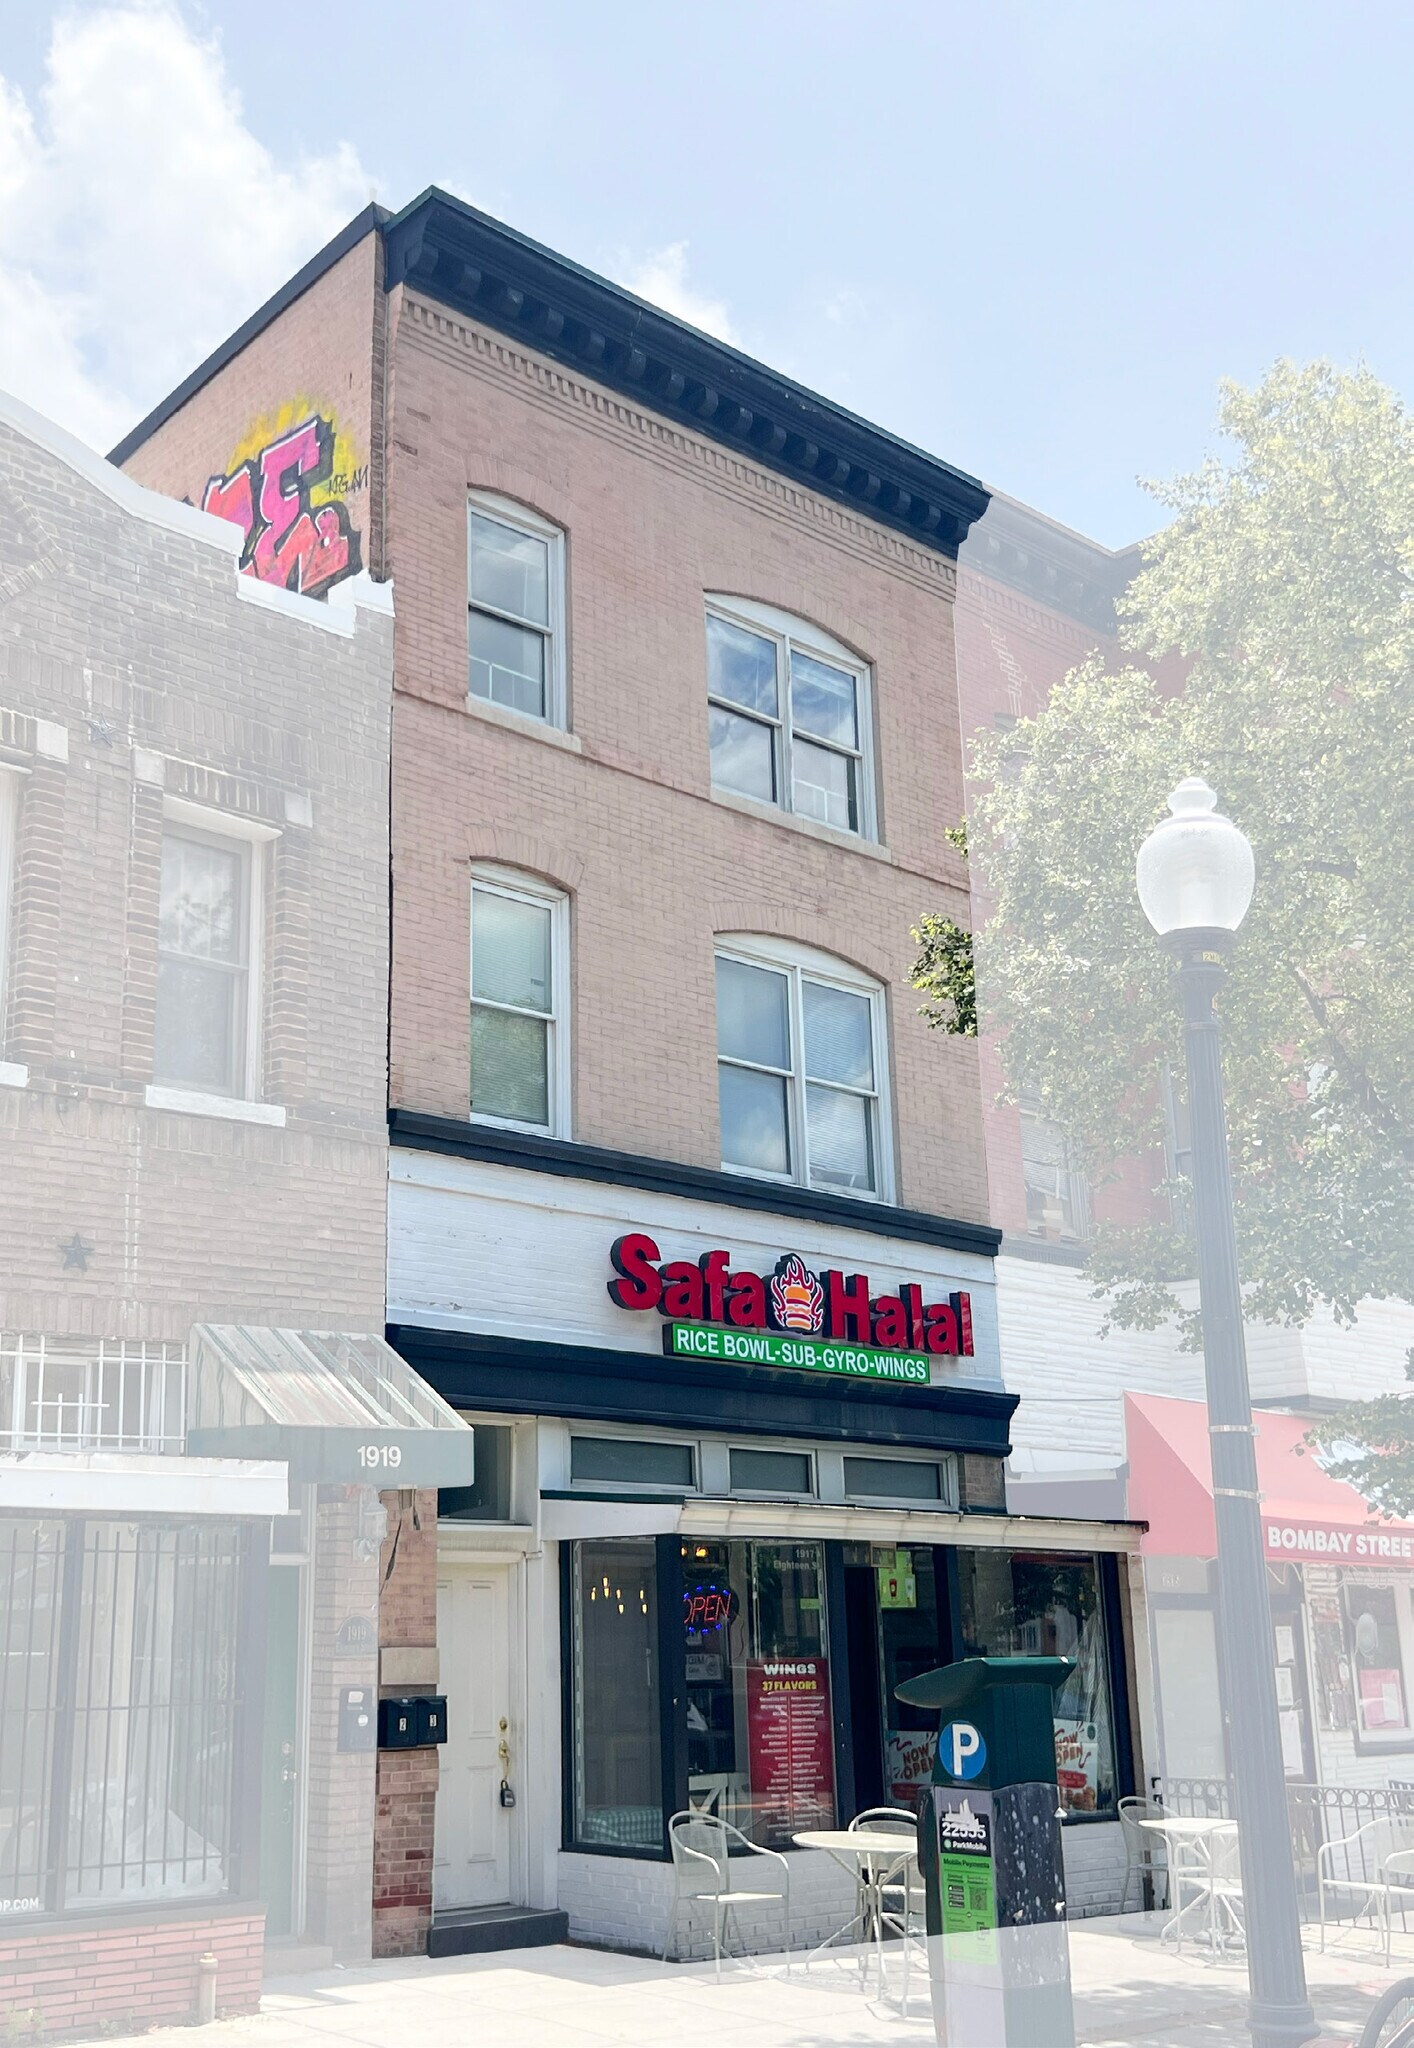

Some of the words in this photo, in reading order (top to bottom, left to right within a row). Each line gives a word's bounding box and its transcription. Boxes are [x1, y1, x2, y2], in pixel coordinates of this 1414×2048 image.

[607, 1233, 767, 1329] Safa
[820, 1270, 975, 1357] Halal
[677, 1328, 719, 1354] RICE
[724, 1334, 927, 1380] BOWL-SUB-GYRO-WINGS
[357, 1445, 401, 1468] 1919
[1267, 1526, 1352, 1554] BOMBAY
[1356, 1534, 1414, 1558] STREE
[796, 1549, 815, 1558] 1917
[347, 1625, 367, 1641] 1919
[763, 1663, 816, 1676] WINGS
[762, 1681, 773, 1692] 37
[774, 1680, 817, 1690] FLAVORS
[903, 1742, 930, 1767] NOW
[952, 1723, 980, 1776] P
[952, 1840, 988, 1851] ParkMobile
[0, 1896, 39, 1912] P.COM
